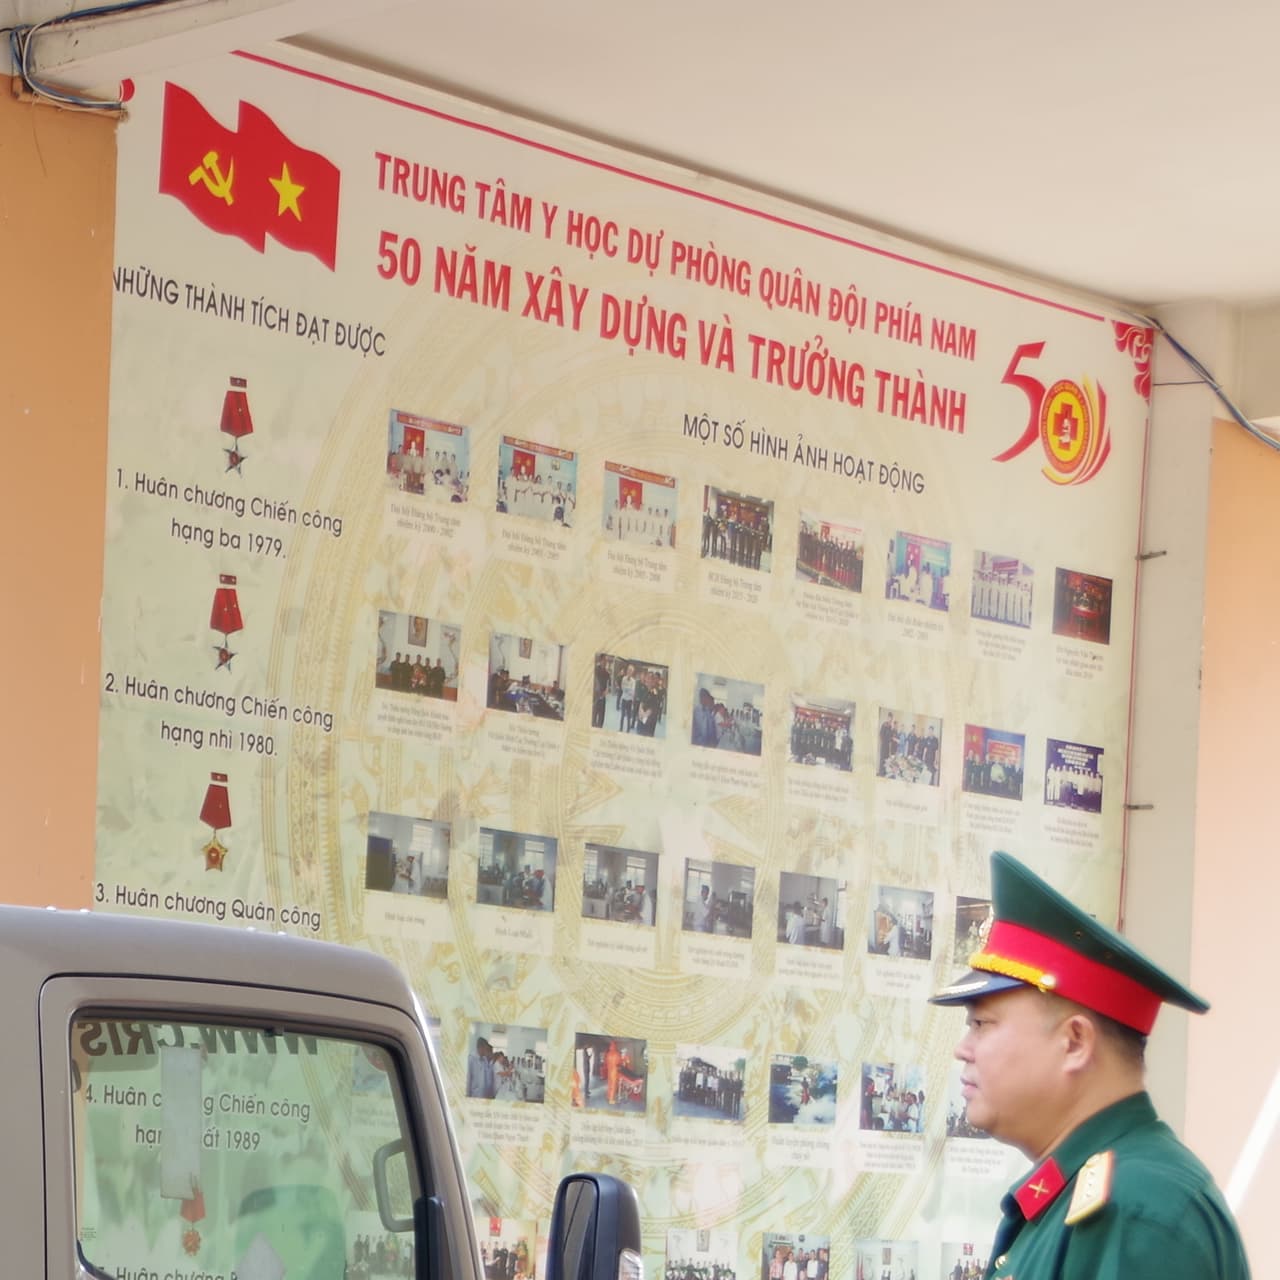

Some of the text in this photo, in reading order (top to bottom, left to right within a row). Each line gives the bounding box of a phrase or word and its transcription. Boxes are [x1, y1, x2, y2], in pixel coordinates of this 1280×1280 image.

[374, 150, 978, 362] TRUNG TÂM Y HỌC DỰ PHÒNG QUÂN ĐỘI PHÍA NAM
[185, 282, 246, 323] THÀNH
[251, 296, 290, 334] TÍCH
[296, 311, 330, 345] ĐẠT
[335, 320, 387, 357] ĐƯỢC
[377, 230, 968, 434] 50 NĂM XÂY DỰNG VÀ TRƯỞNG THÀNH
[683, 411, 926, 495] MỘT SỐ HÌNH ẢNH HOẠT ĐỘNG
[115, 468, 344, 537] 1. Huân chương Chiến công
[171, 518, 287, 559] hạng ba 1979.
[105, 672, 334, 733] 2. Huân chương Chiến công
[161, 720, 278, 757] hạng nhì 1980.
[95, 882, 322, 932] 3. Huân chương Quân công
[103, 1085, 147, 1107] Huân
[220, 1094, 265, 1115] Chiến
[270, 1100, 311, 1123] công
[227, 1130, 261, 1151] 1989
